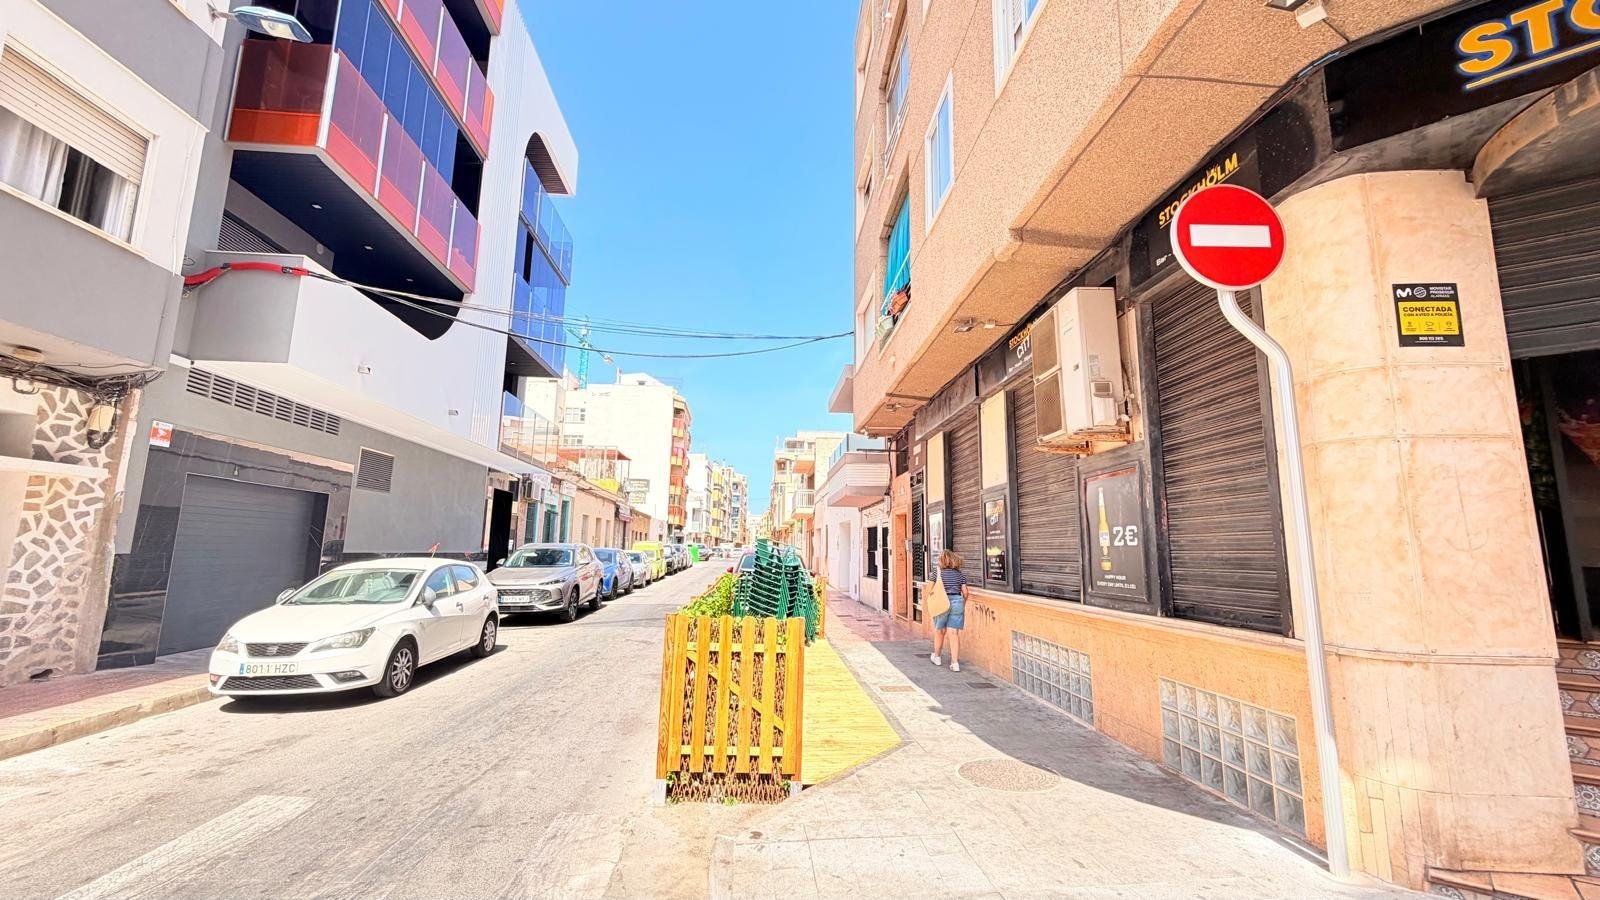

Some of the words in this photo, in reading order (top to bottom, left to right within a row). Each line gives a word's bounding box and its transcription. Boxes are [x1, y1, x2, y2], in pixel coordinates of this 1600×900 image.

[1112, 525, 1138, 547] 2€
[246, 664, 270, 674] 8011
[274, 663, 296, 673] HZC
